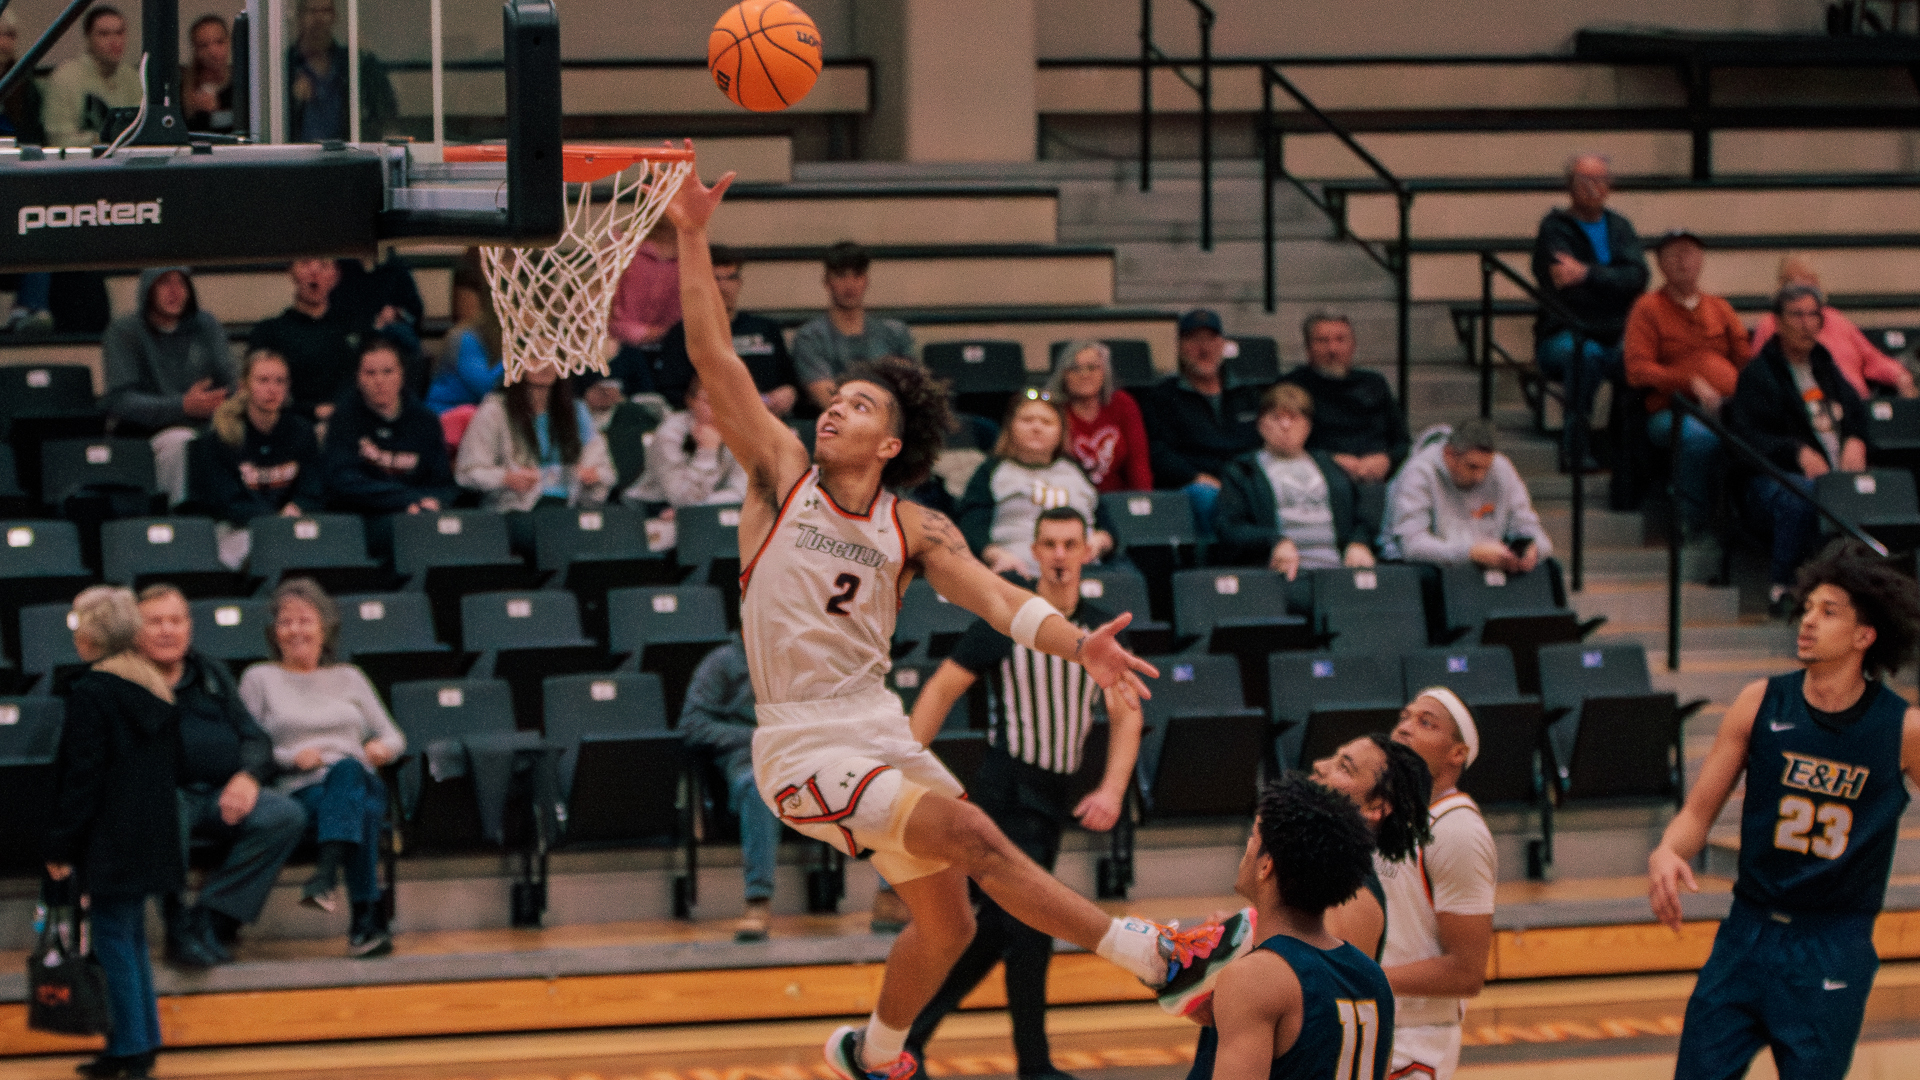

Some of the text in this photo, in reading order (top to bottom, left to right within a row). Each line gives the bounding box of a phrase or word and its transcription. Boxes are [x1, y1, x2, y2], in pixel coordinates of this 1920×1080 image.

[826, 572, 862, 616] 2
[1781, 750, 1870, 800] E&H
[1773, 794, 1853, 861] 23
[1335, 998, 1379, 1080] 11
